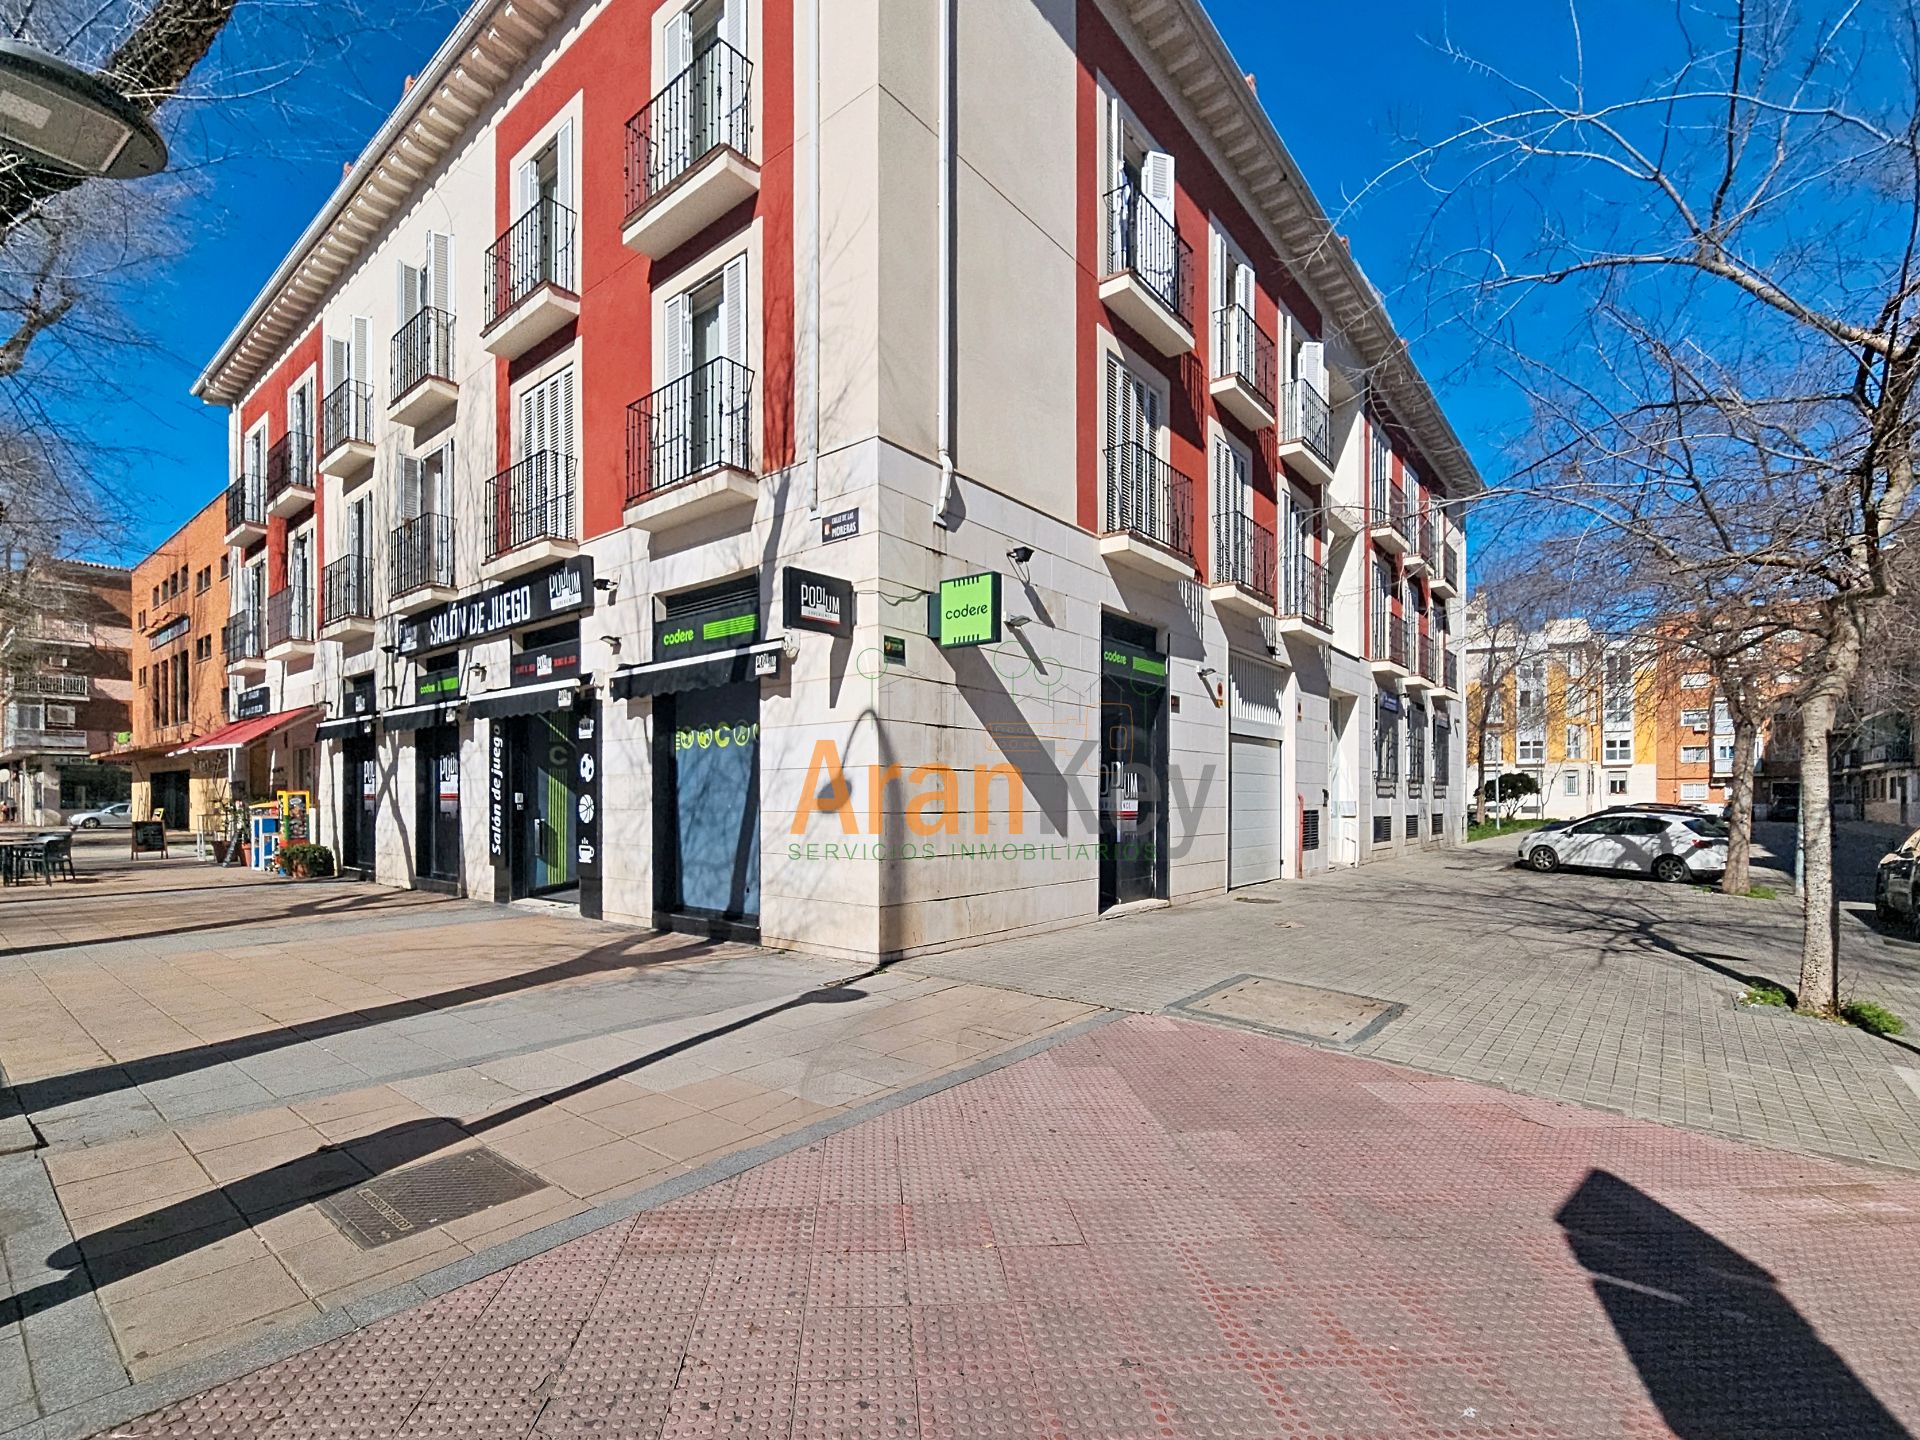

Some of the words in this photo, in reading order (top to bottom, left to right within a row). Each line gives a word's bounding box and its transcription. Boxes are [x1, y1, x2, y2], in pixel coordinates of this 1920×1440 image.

[832, 522, 856, 537] MORERAS
[549, 566, 581, 599] PODIUM
[801, 584, 840, 614] PODIUM
[945, 603, 988, 620] codere
[430, 603, 467, 646] SALÓN
[469, 602, 485, 635] DE
[487, 585, 531, 632] JUEGO
[663, 629, 694, 646] codere
[1104, 650, 1127, 665] codere
[491, 723, 504, 779] juego
[491, 778, 502, 801] de
[1100, 761, 1139, 799] ODIUM
[491, 804, 502, 856] Salón
